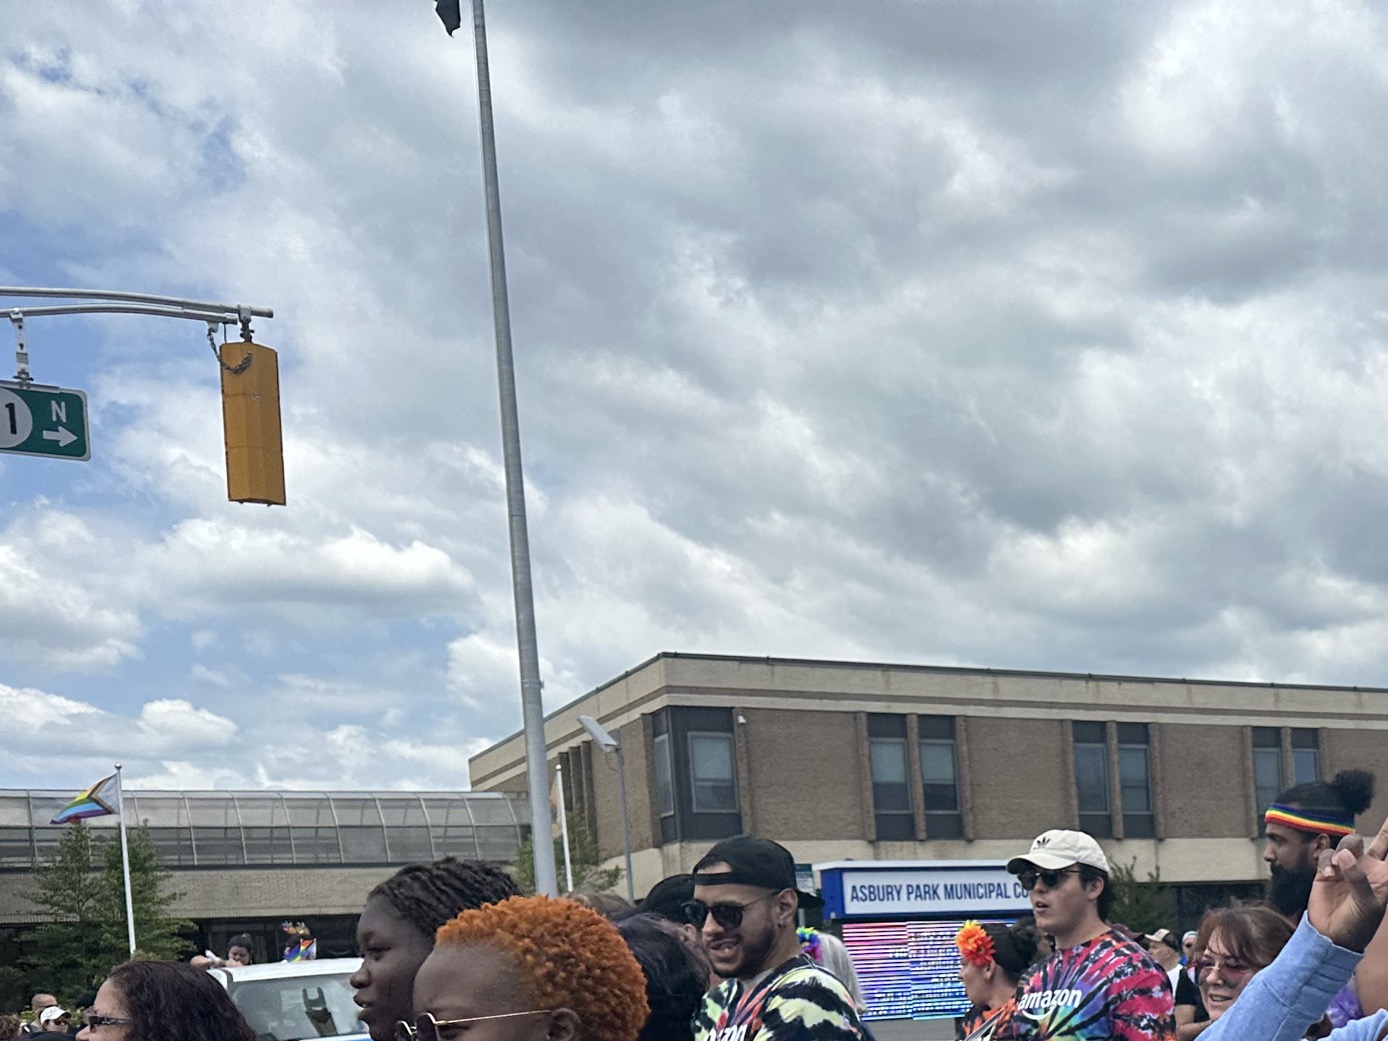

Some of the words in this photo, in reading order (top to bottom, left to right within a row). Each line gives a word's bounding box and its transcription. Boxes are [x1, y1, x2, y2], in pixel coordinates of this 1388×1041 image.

[5, 402, 17, 435] 1
[51, 400, 67, 423] N
[850, 884, 902, 902] ASBURY
[906, 883, 941, 902] PARK
[943, 882, 1011, 901] MUNICIPAL
[1018, 988, 1083, 1010] amazon
